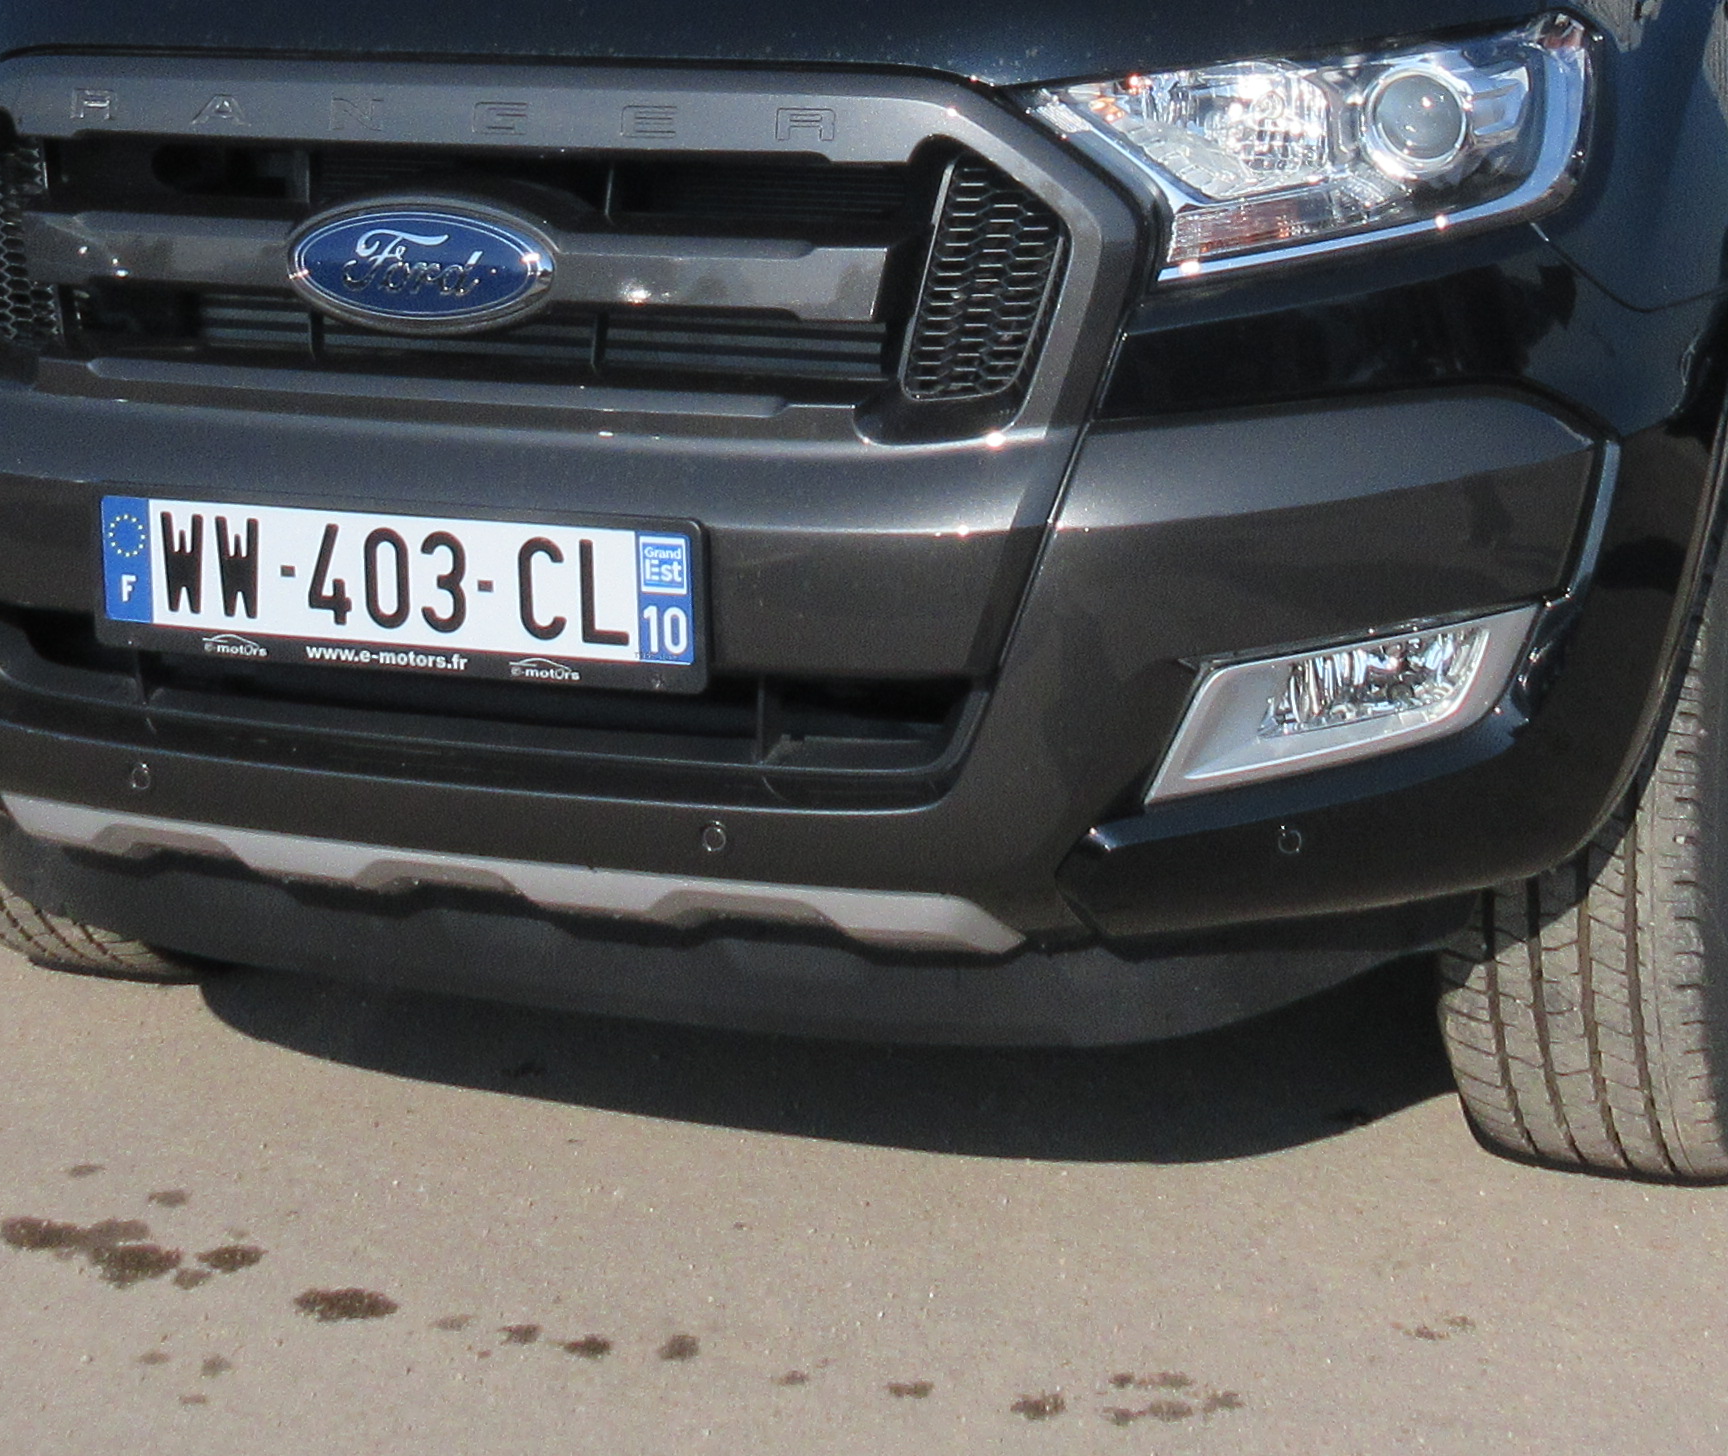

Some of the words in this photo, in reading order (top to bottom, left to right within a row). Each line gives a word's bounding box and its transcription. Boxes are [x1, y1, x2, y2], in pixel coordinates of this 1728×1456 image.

[73, 89, 837, 143] RANGER
[341, 228, 484, 298] Ford
[645, 544, 682, 561] Grand
[646, 560, 683, 582] Est
[121, 574, 136, 602] F
[160, 511, 630, 647] WW-403-CL
[643, 605, 688, 655] 10
[305, 643, 469, 672] www.e-motors.fr
